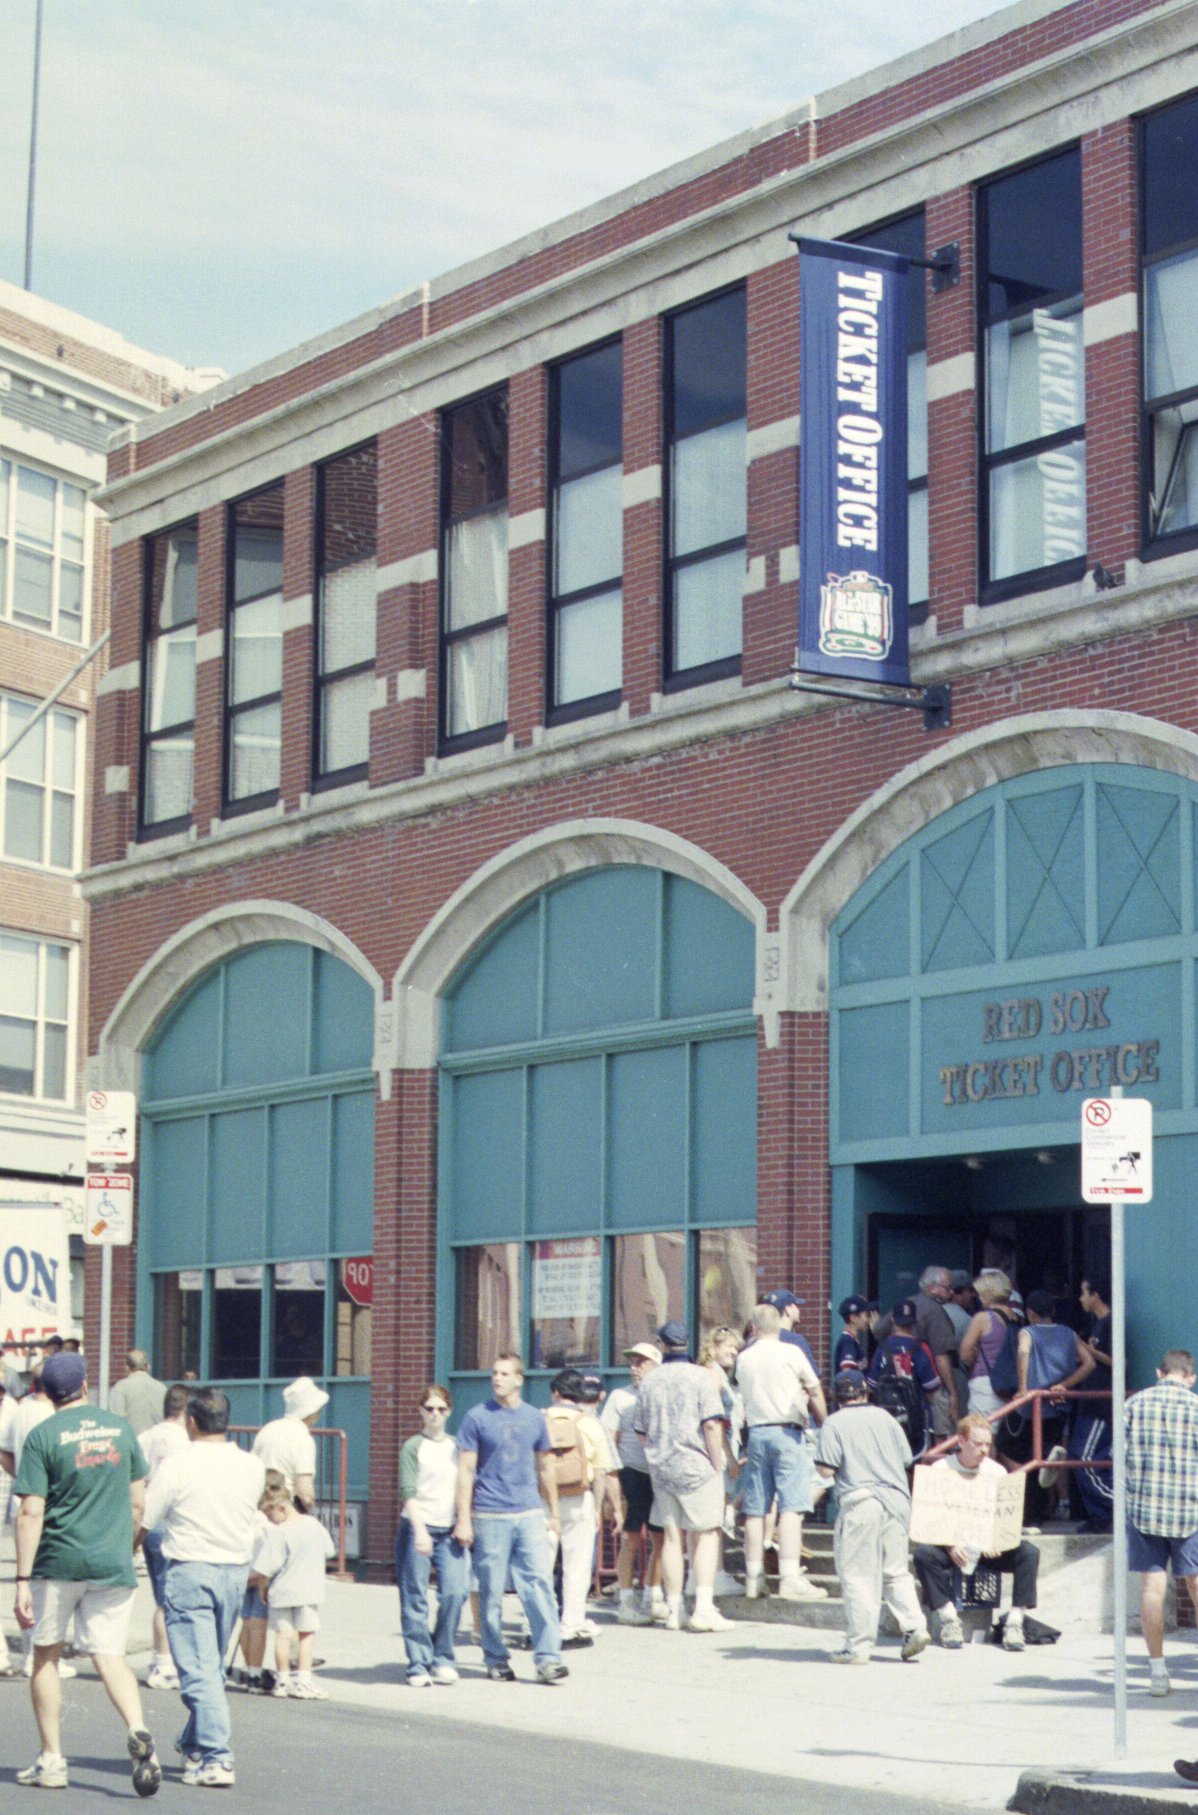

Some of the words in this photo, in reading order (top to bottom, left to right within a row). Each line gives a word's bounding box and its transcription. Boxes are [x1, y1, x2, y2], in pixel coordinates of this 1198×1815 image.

[837, 270, 884, 413] TICKET
[837, 413, 884, 553] OFFICE
[982, 998, 1042, 1044] RED
[1051, 986, 1111, 1035] SOX
[939, 1054, 1044, 1105] TICKET
[1051, 1039, 1161, 1092] OFFICE
[60, 1426, 122, 1446] Budweiser
